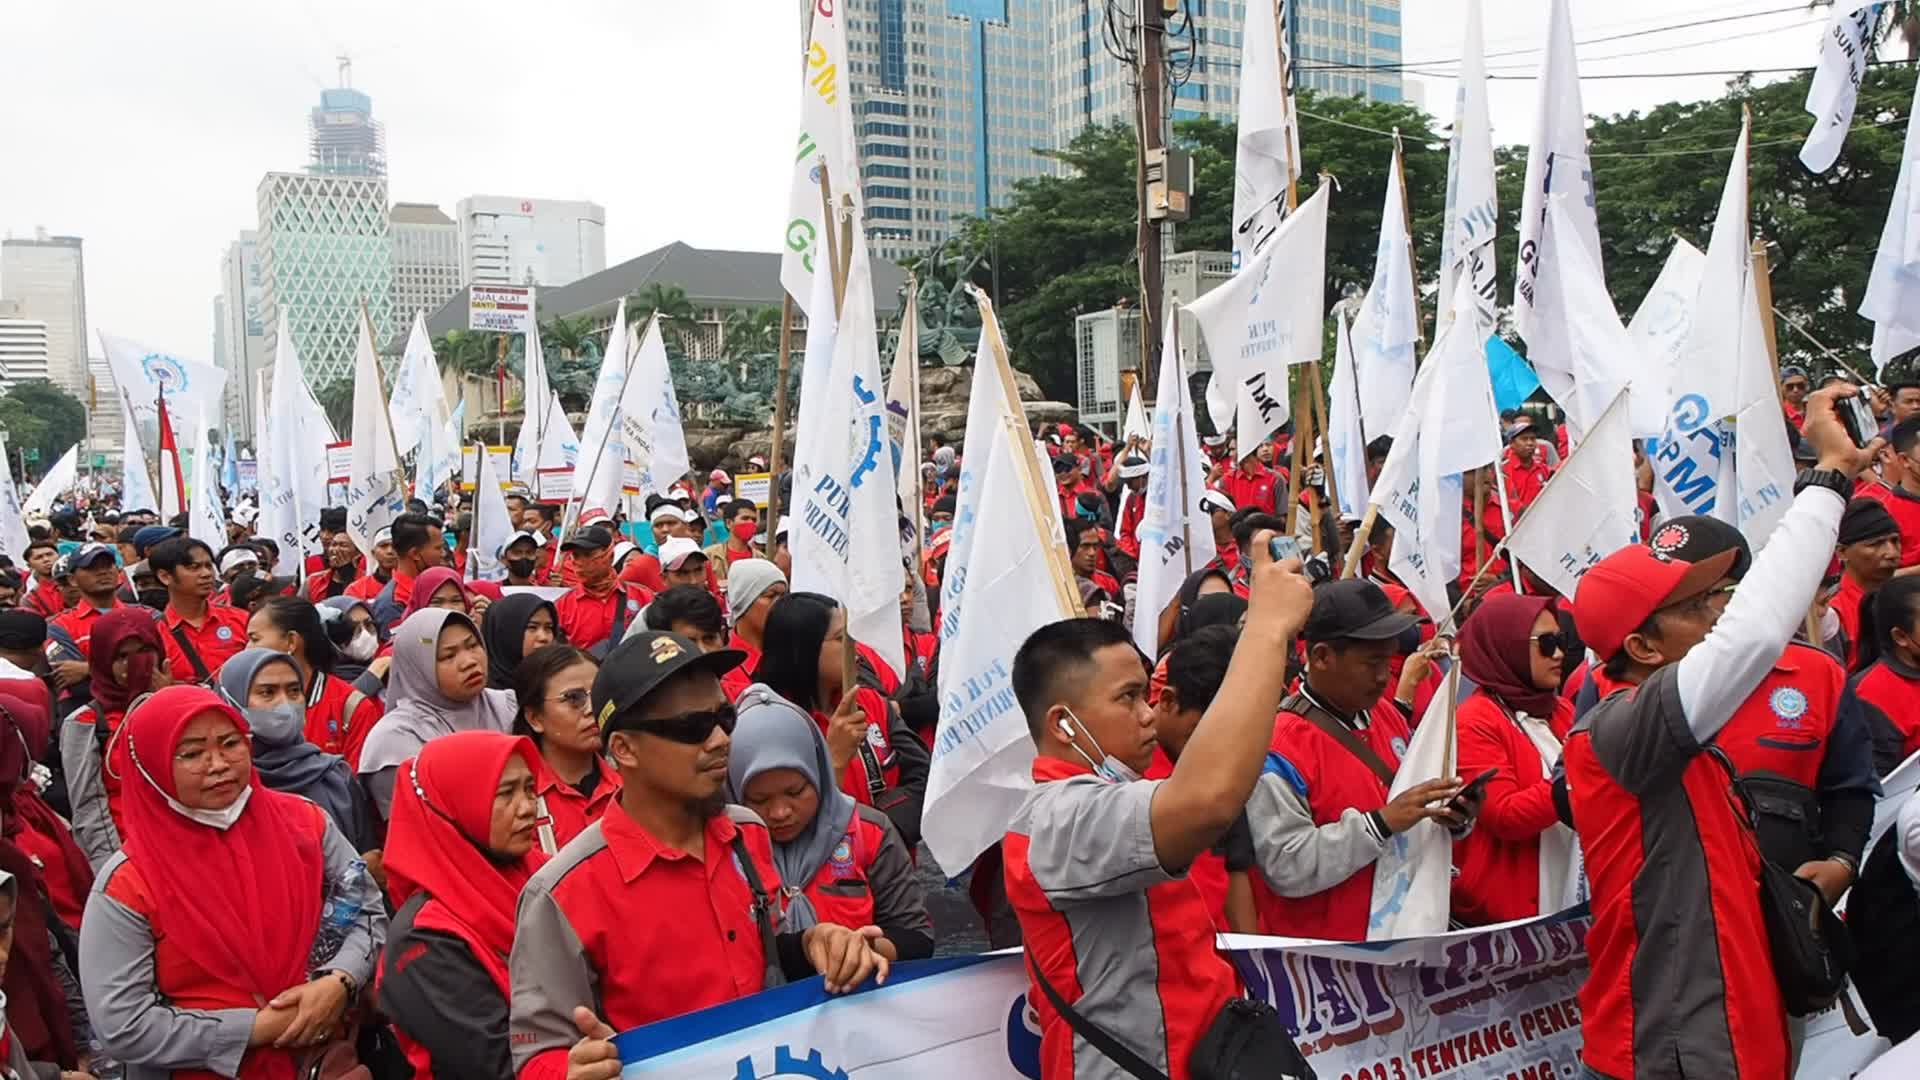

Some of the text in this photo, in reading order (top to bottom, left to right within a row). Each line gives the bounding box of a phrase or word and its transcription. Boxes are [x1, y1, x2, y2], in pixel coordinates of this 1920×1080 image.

[1833, 25, 1856, 58] SUN
[814, 474, 850, 520] PUK
[1412, 1020, 1518, 1080] TENTANG
[1520, 997, 1582, 1042] PENE
